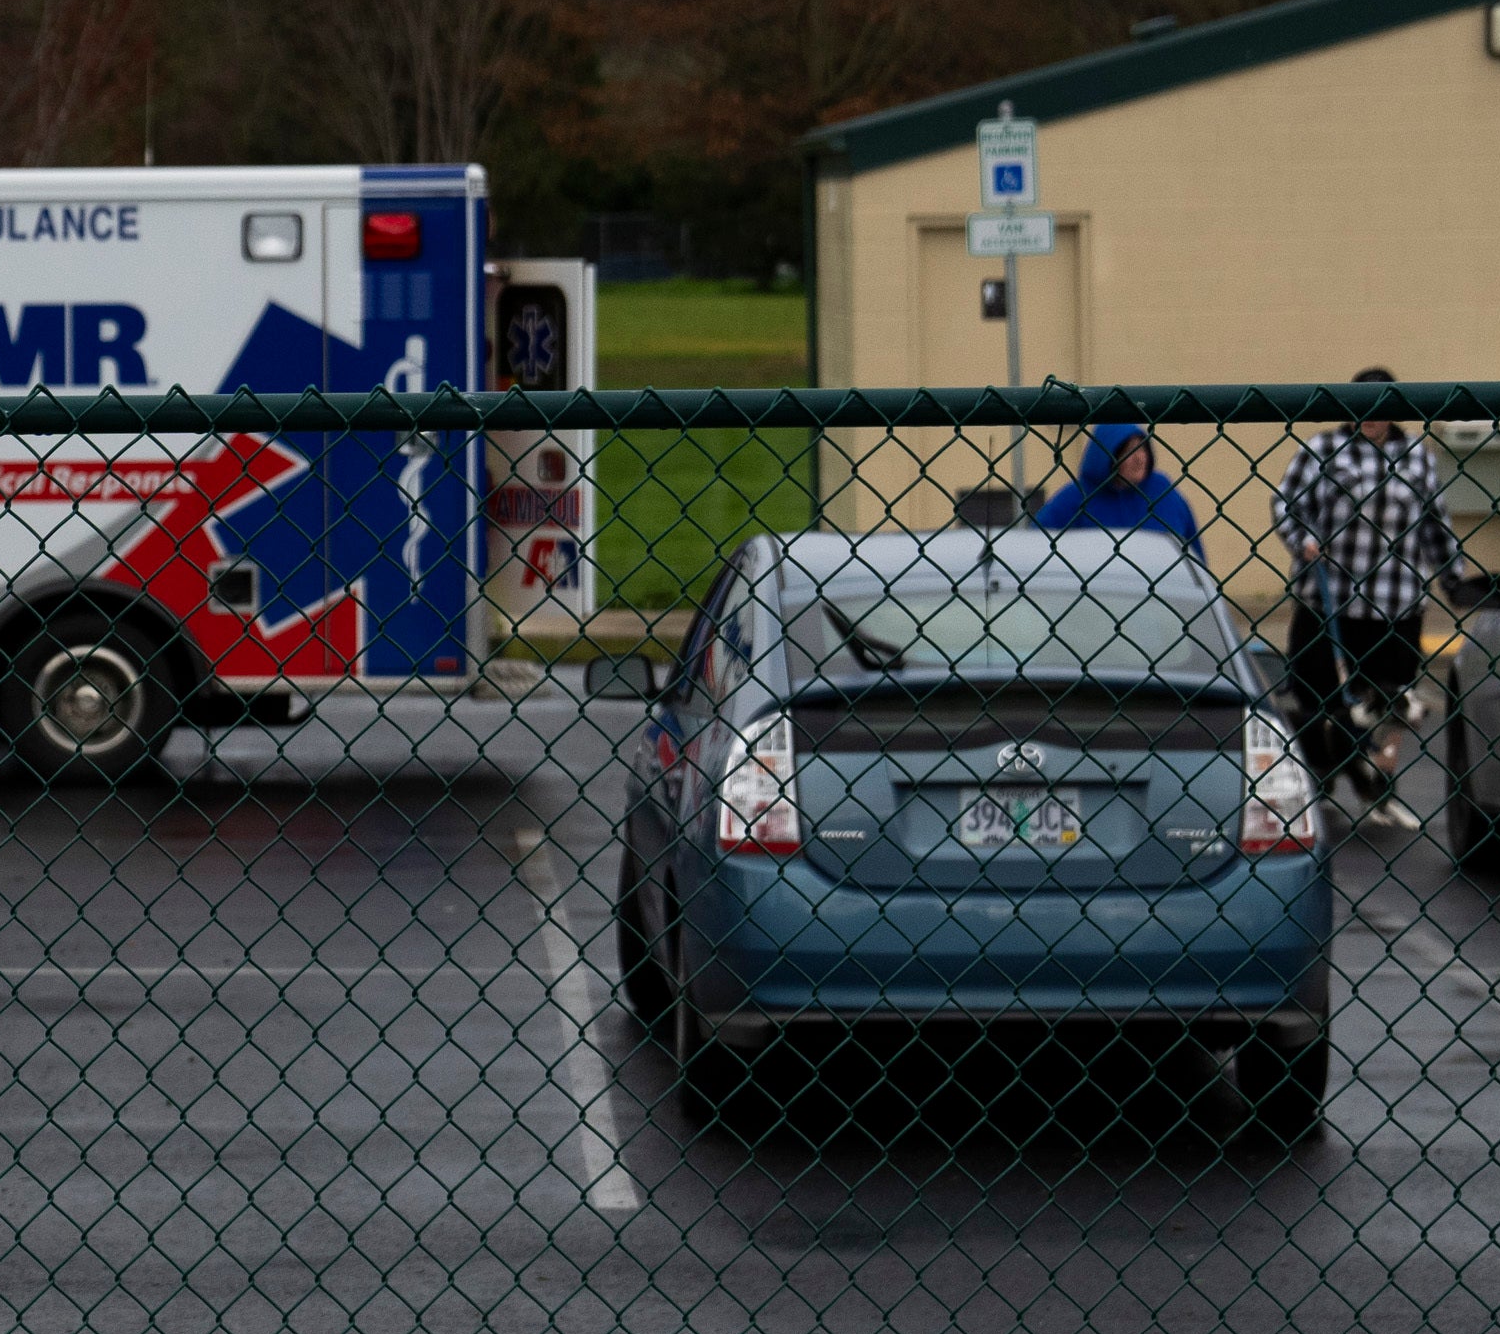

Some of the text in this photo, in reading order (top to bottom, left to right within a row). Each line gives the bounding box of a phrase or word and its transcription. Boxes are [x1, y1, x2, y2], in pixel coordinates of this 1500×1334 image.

[50, 466, 197, 500] Response
[967, 800, 1076, 831] 394 JCE
